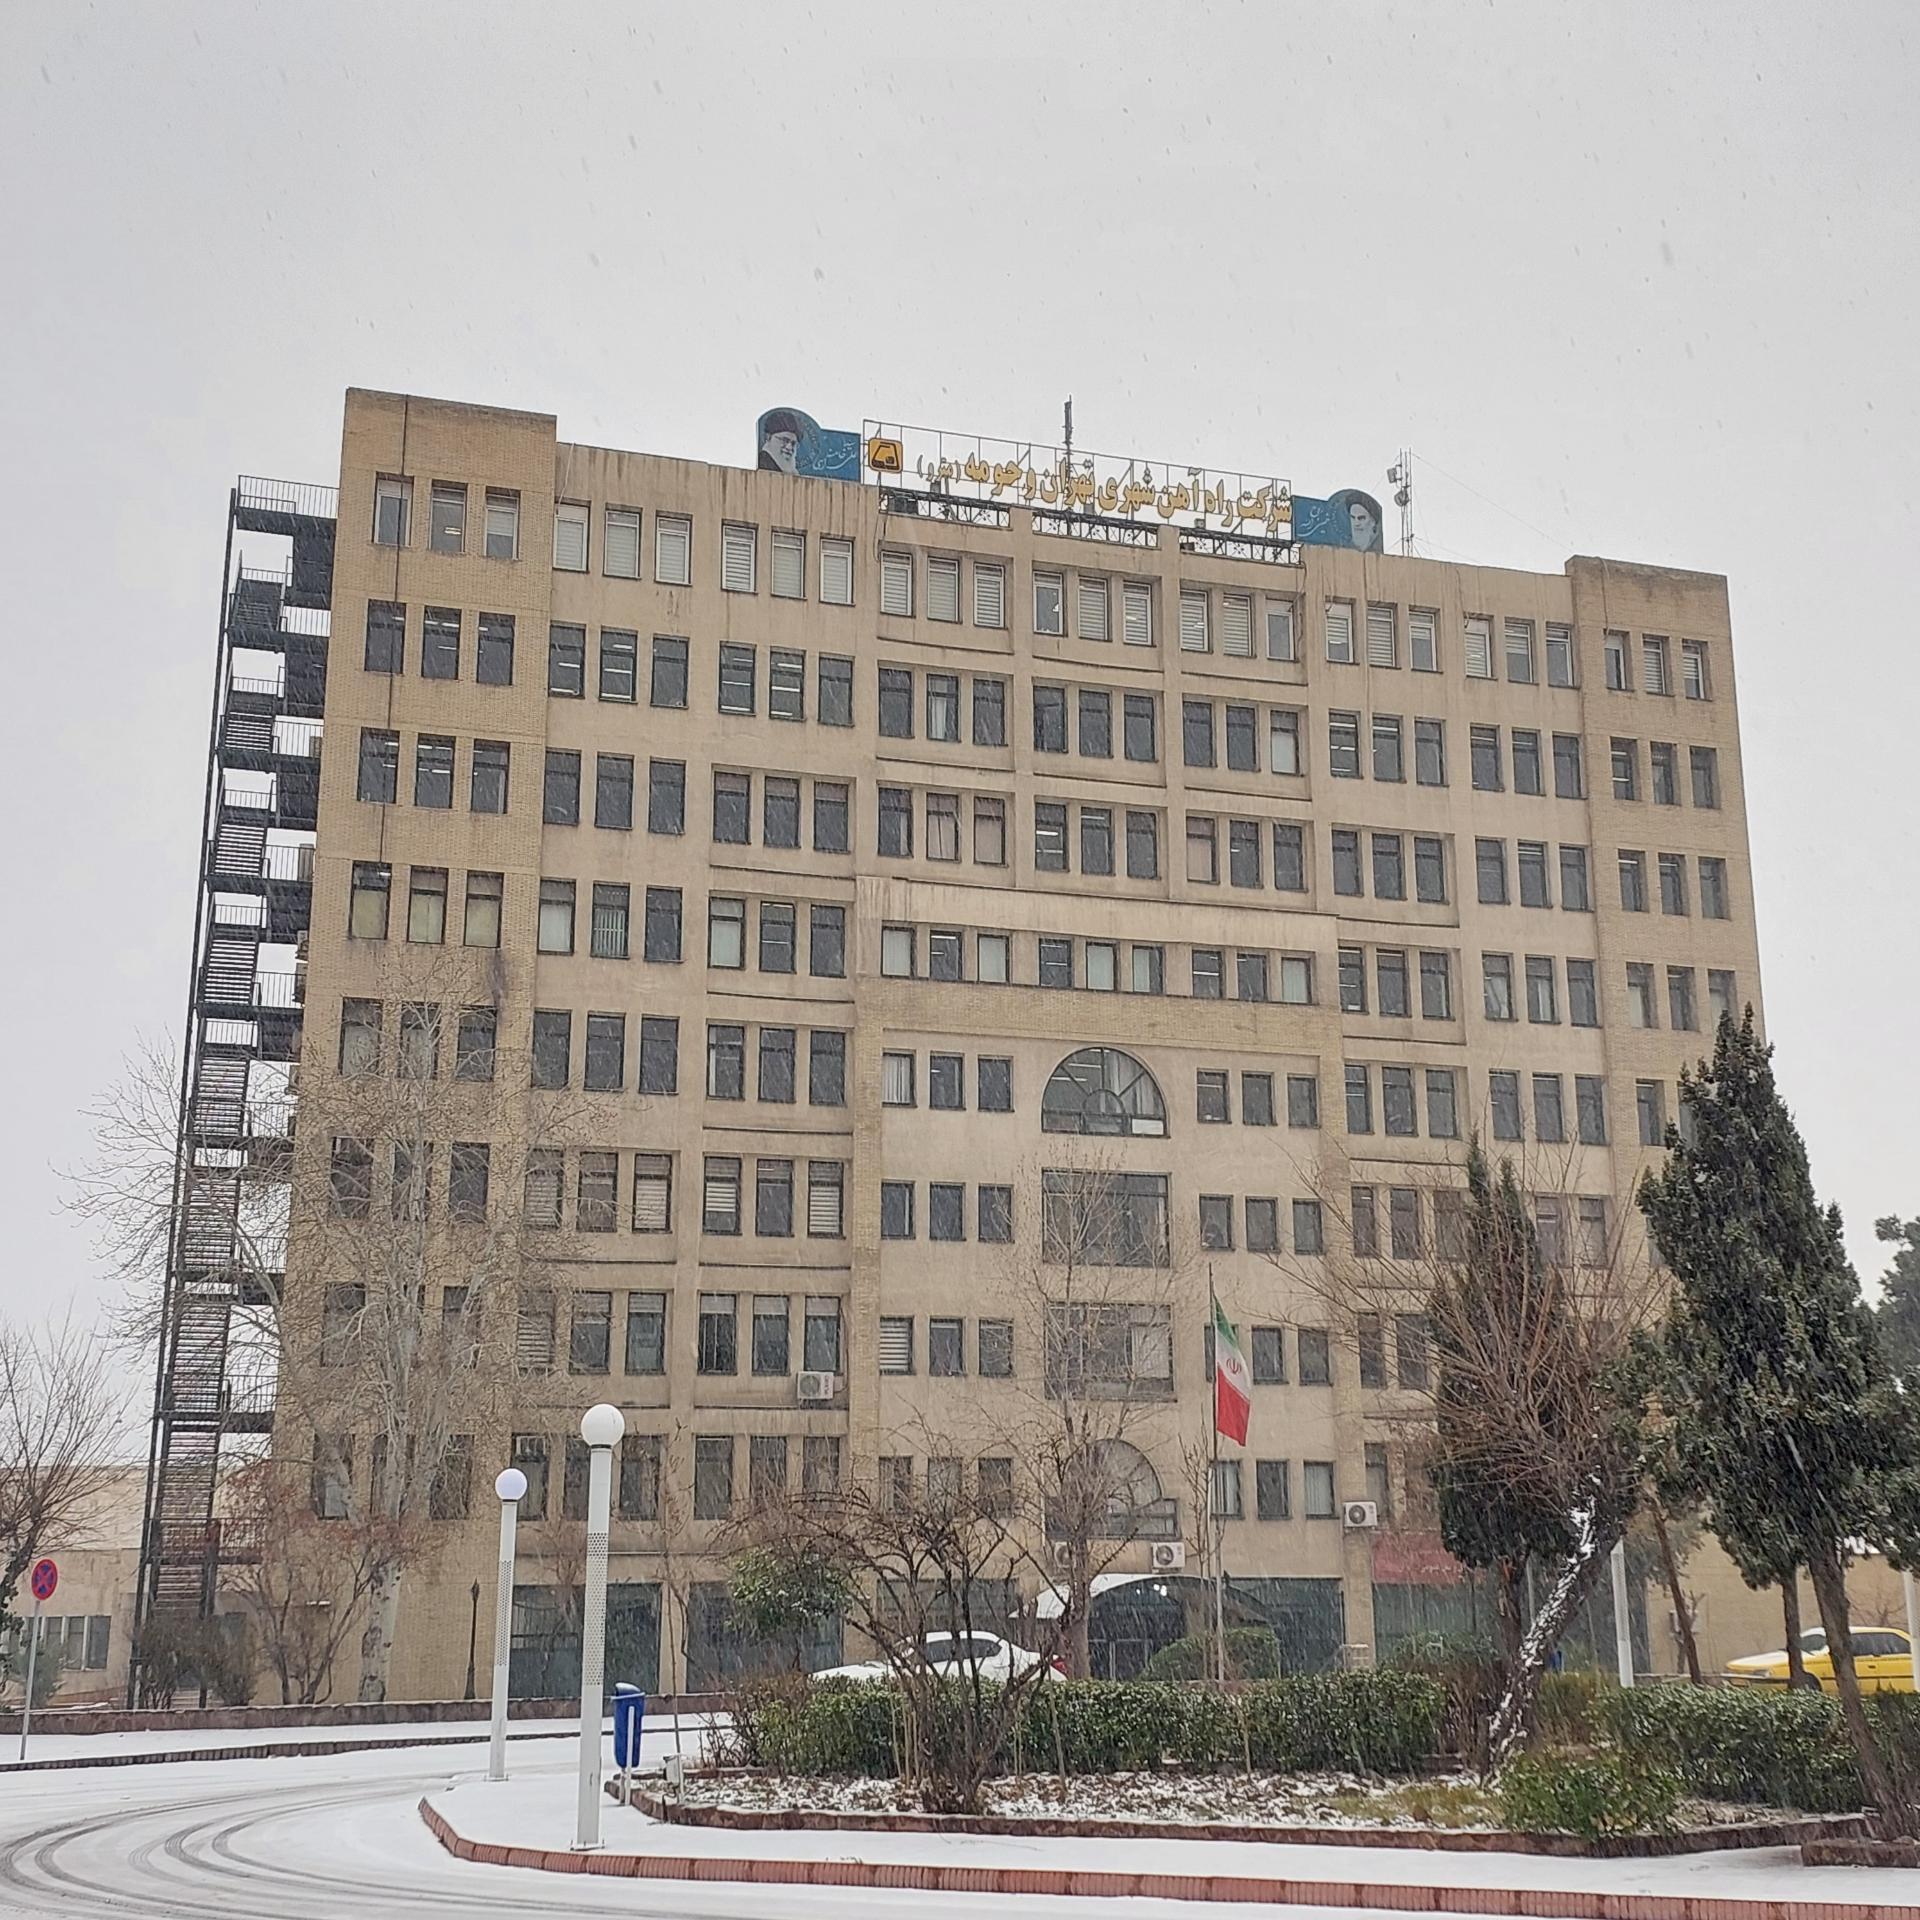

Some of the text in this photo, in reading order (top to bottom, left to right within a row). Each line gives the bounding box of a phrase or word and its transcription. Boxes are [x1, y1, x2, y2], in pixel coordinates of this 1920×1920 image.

[1023, 468, 1037, 500] و
[1040, 457, 1095, 506] تهران
[1098, 466, 1156, 513] شهری
[1157, 467, 1202, 518] آهن
[1204, 479, 1233, 527] راه
[1237, 484, 1292, 532] شرکت
